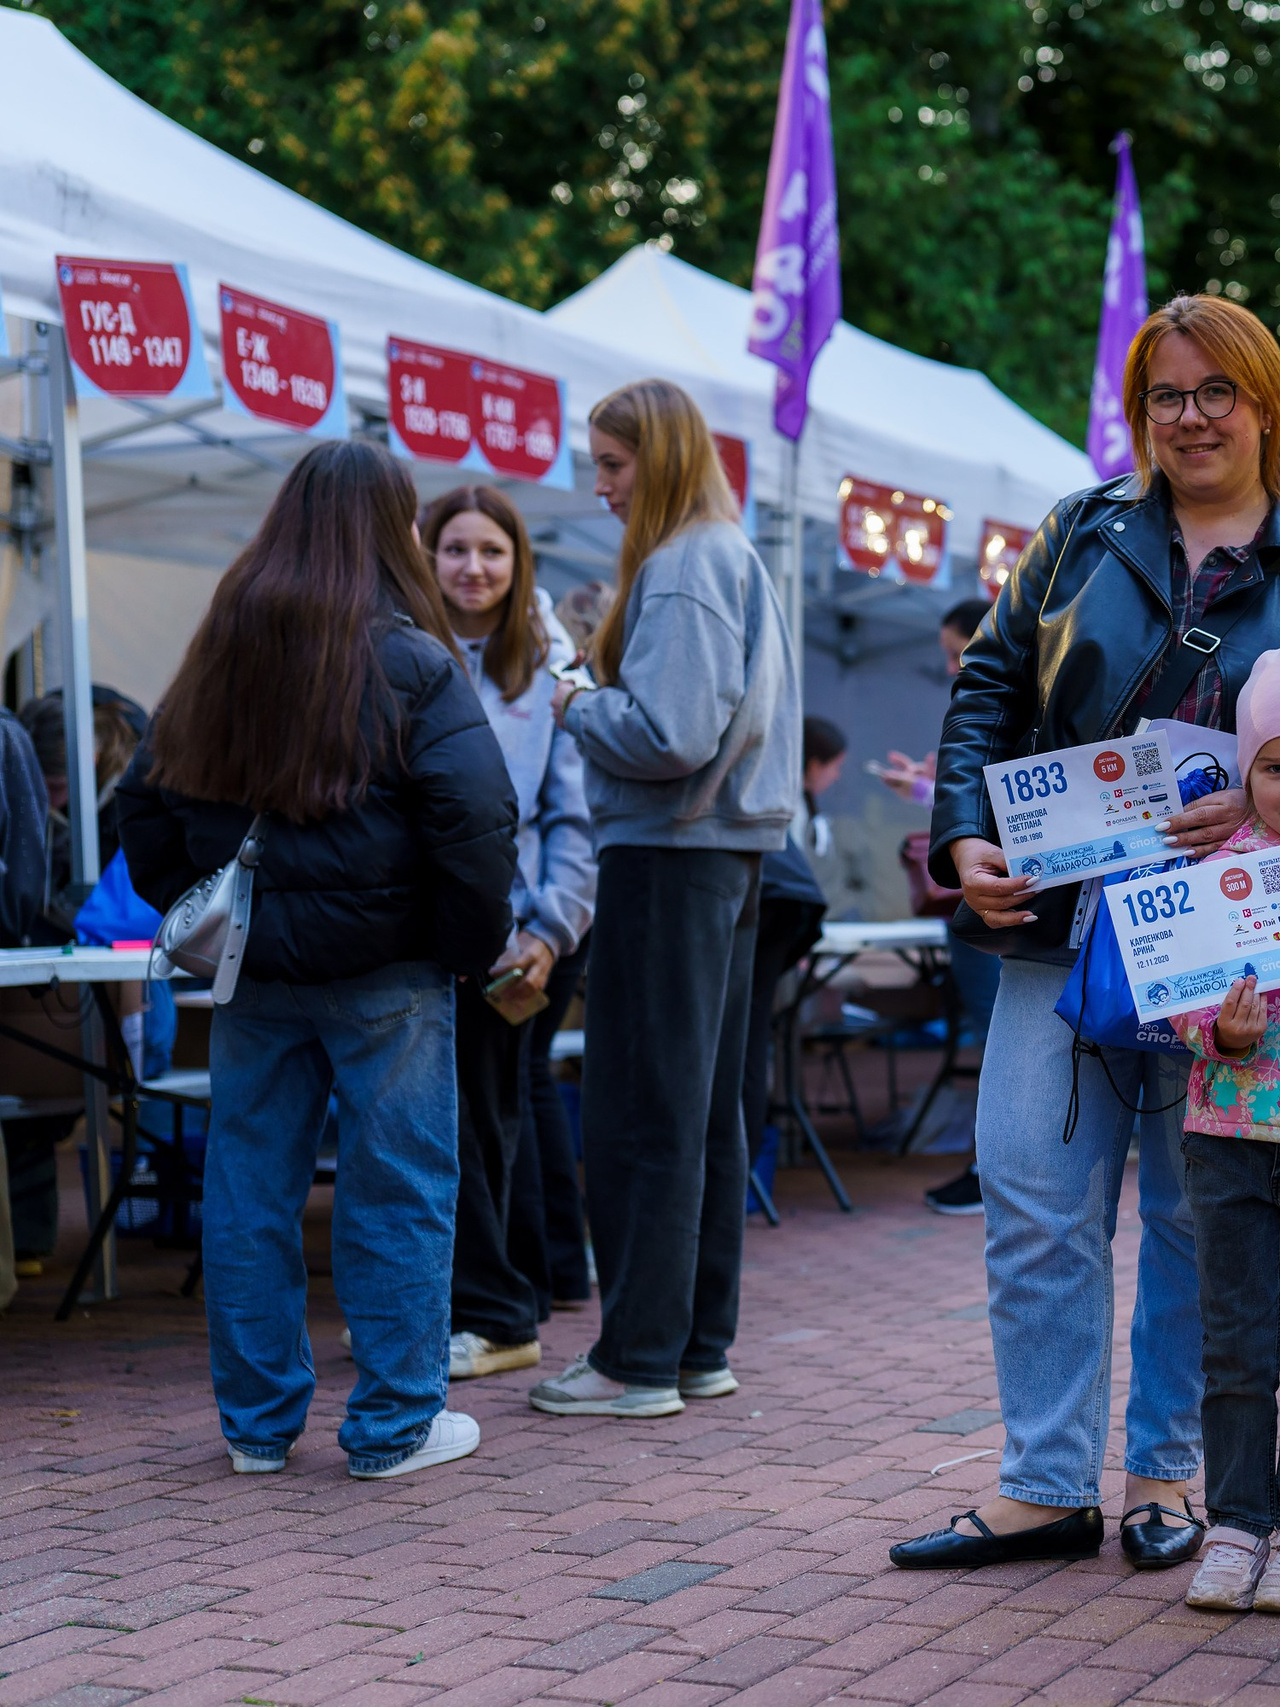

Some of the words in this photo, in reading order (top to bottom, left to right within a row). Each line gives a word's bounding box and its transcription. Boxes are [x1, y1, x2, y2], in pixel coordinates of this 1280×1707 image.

[80, 300, 137, 336] ГУС-Д
[88, 335, 132, 366] 1149
[143, 336, 182, 367] 1347
[236, 327, 270, 363] Е-Ж
[1107, 764, 1118, 773] КМ
[1000, 762, 1068, 804] 1833
[1132, 798, 1147, 807] Пэй
[1006, 808, 1048, 824] КАРПЕНКОВА
[1008, 818, 1042, 833] СВЕТЛАНА
[1012, 832, 1043, 845] 15.09.1990
[1130, 835, 1164, 850] СПОРТ
[1061, 844, 1094, 858] КАЛУЖСКИЙ
[1052, 856, 1097, 874] МАРАФОН
[1226, 882, 1240, 893] 300
[1241, 880, 1247, 889] М
[1123, 880, 1195, 927] 1832
[1262, 919, 1276, 928] Пэй
[1130, 929, 1174, 948] КАРПЕНКОВА
[1133, 944, 1155, 957] АРИНА
[1136, 954, 1170, 969] 12.11.2020
[1188, 967, 1224, 983] КАЛУЖСКИЙ
[1180, 978, 1228, 1000] МАРАФОН
[1138, 1024, 1159, 1032] PRO
[1136, 1032, 1182, 1043] СПОР
